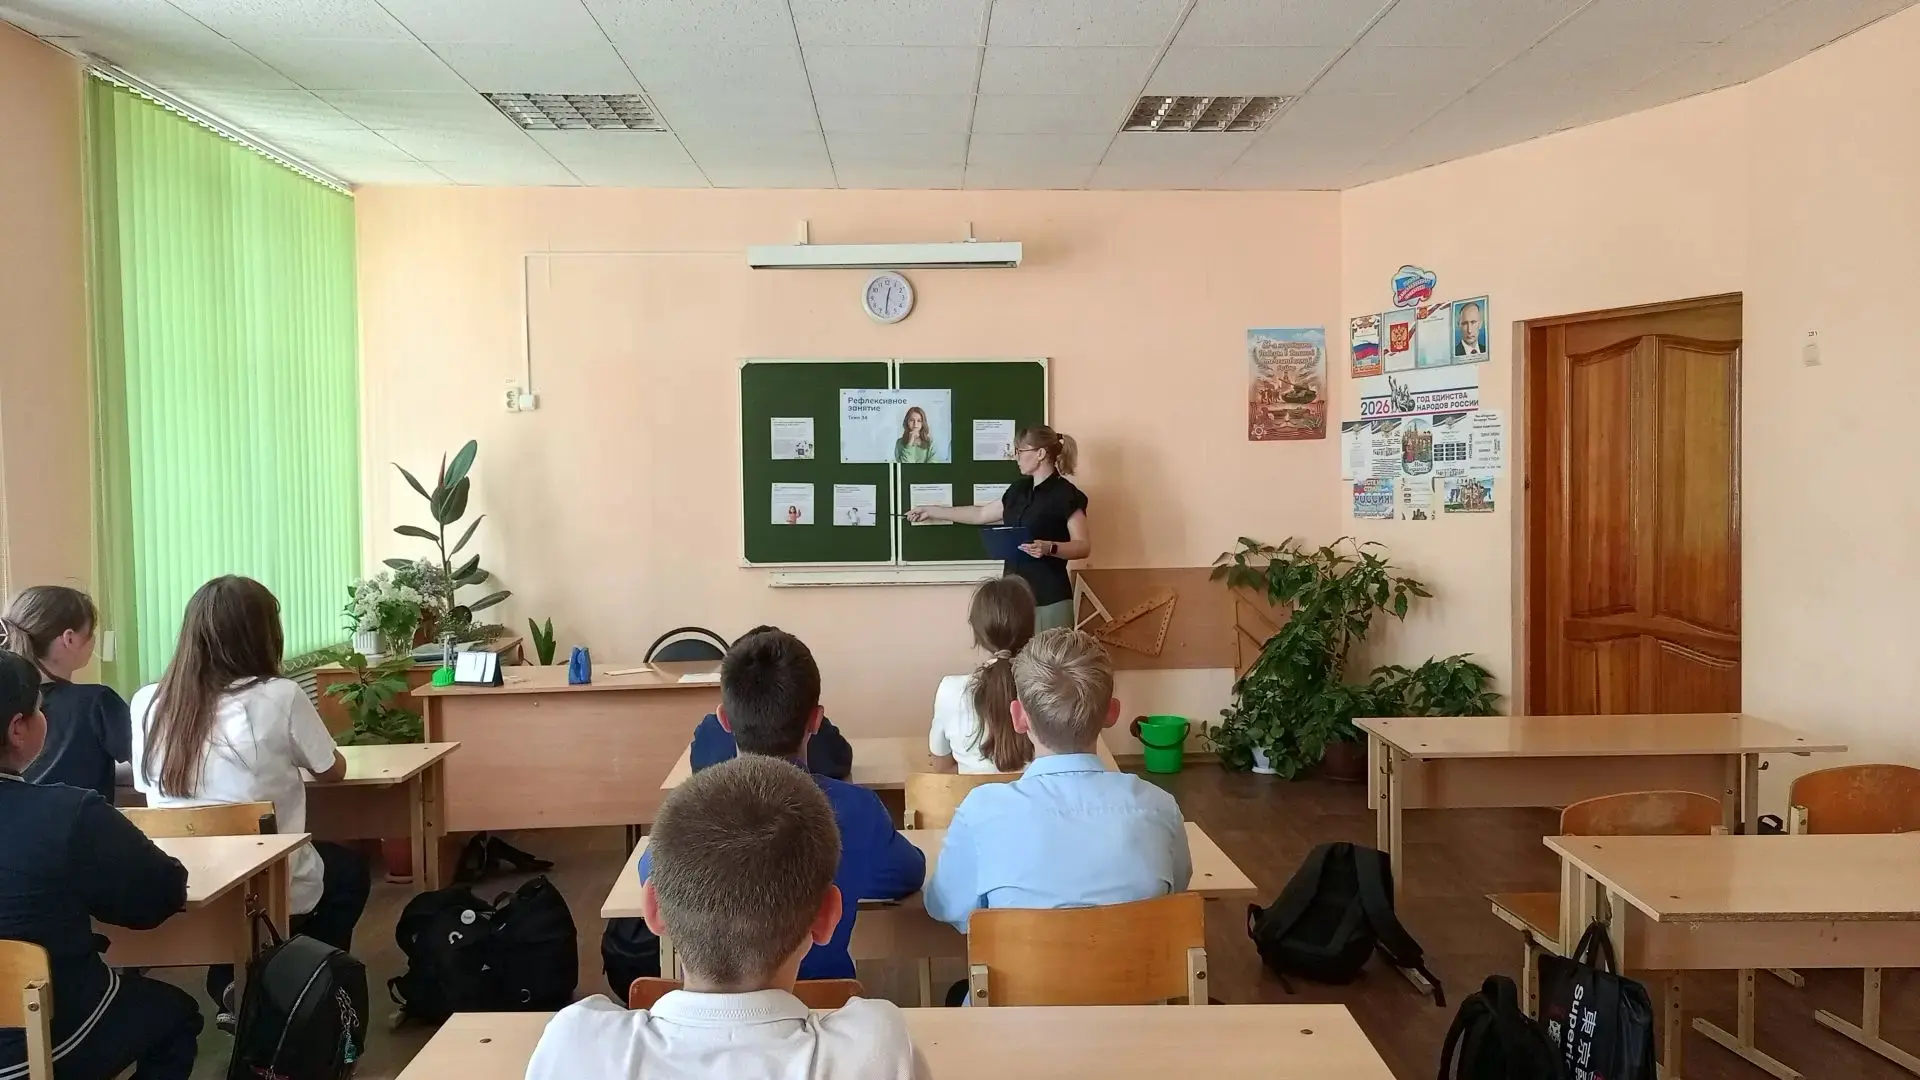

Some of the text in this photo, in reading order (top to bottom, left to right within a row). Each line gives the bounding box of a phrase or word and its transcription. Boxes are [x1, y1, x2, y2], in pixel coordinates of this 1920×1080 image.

[847, 397, 908, 405] Рефлексивное
[1416, 392, 1468, 403] ГОД ЕДИНСТВА
[1360, 400, 1390, 416] 2026
[1416, 400, 1479, 411] НАРОДОВ РОССИИ
